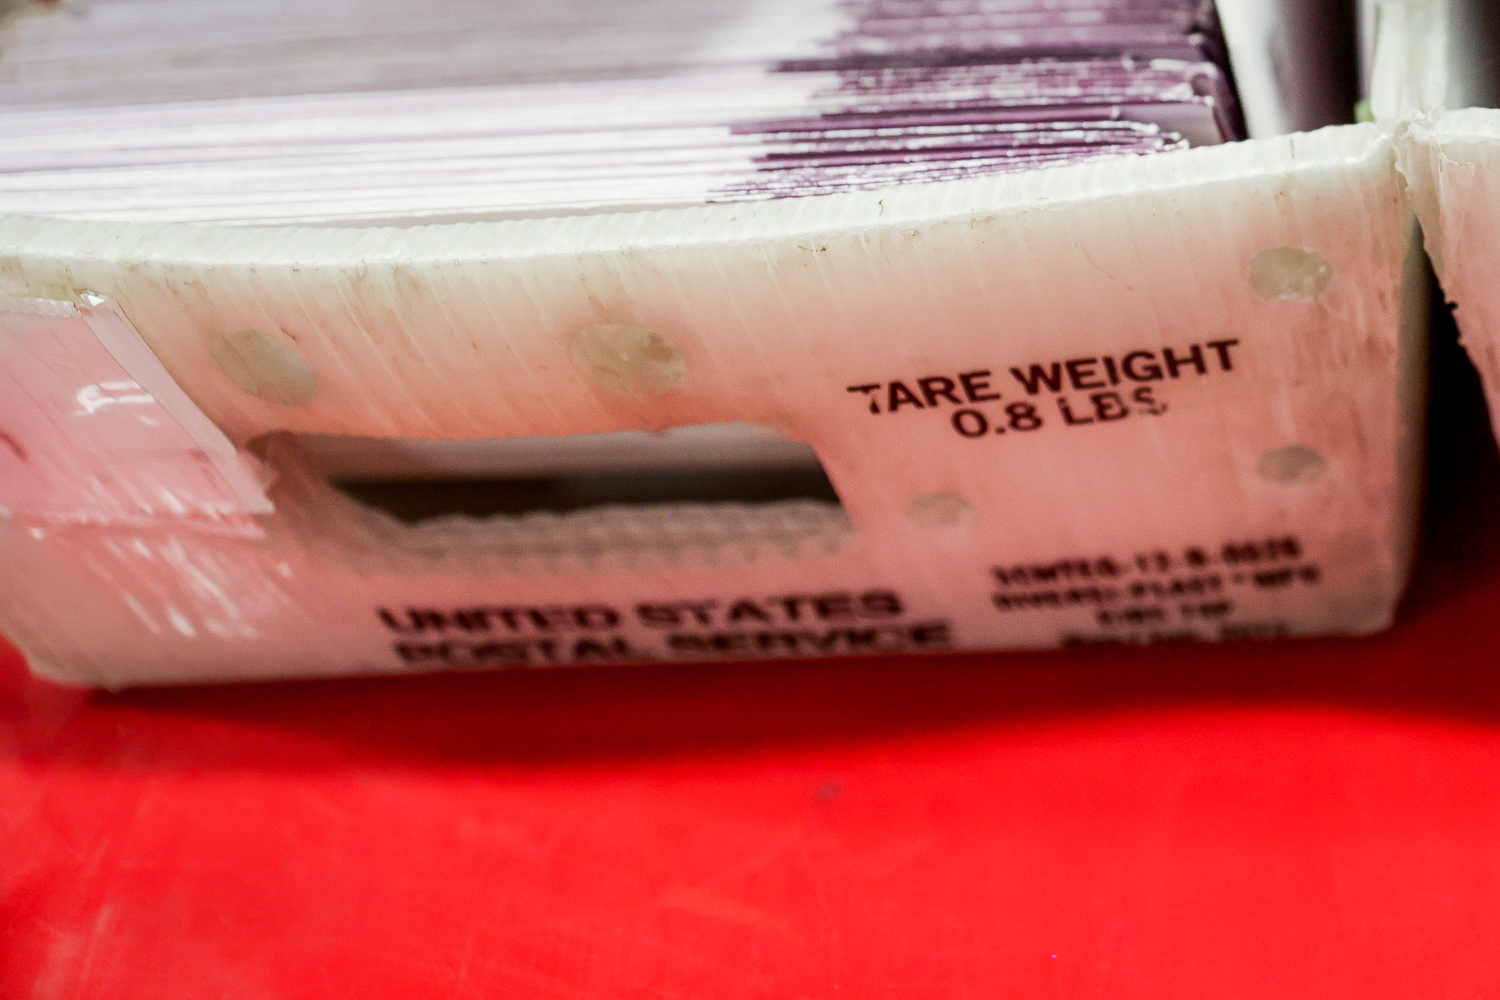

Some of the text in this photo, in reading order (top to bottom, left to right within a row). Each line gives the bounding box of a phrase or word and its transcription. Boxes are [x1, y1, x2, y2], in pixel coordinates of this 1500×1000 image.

[847, 339, 1240, 414] TARE WEIGHT
[951, 401, 1043, 438] 0.8
[376, 590, 904, 633] UNITED STATES
[393, 620, 952, 663] POSTAL SERVICE
